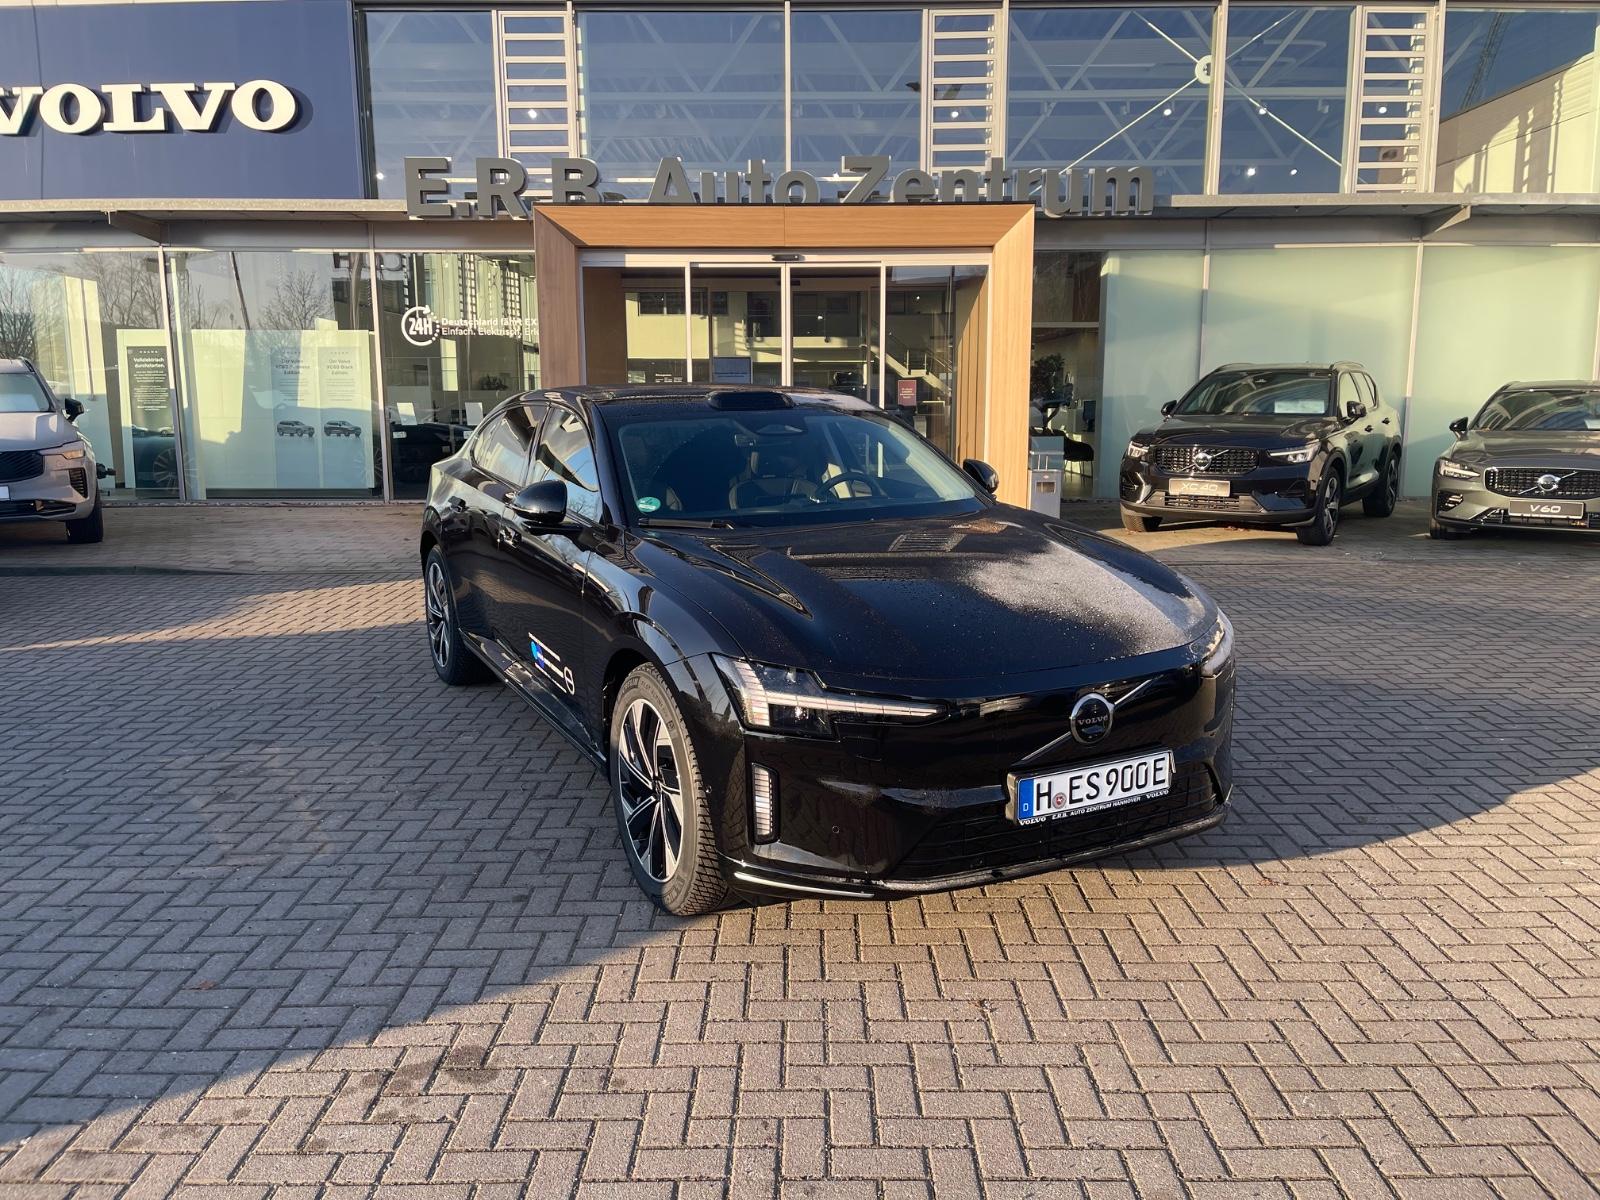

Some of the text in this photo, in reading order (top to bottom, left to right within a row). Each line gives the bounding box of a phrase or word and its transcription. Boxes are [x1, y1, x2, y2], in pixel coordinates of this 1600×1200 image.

[649, 157, 821, 203] Auto
[841, 155, 1154, 218] Zentrum
[408, 318, 433, 335] 24H
[441, 317, 498, 326] Deutschland
[501, 317, 522, 326] fährt
[441, 327, 476, 336] Einfach.
[478, 327, 522, 336] Elektrisch.
[1078, 714, 1108, 725] VOLVO
[1036, 781, 1052, 811] H
[1019, 816, 1047, 826] VOLVO
[1070, 808, 1086, 816] AUTO
[1085, 802, 1112, 813] ZENTRUM
[1112, 796, 1141, 807] HANNOVER
[1145, 789, 1169, 799] VOLVO
